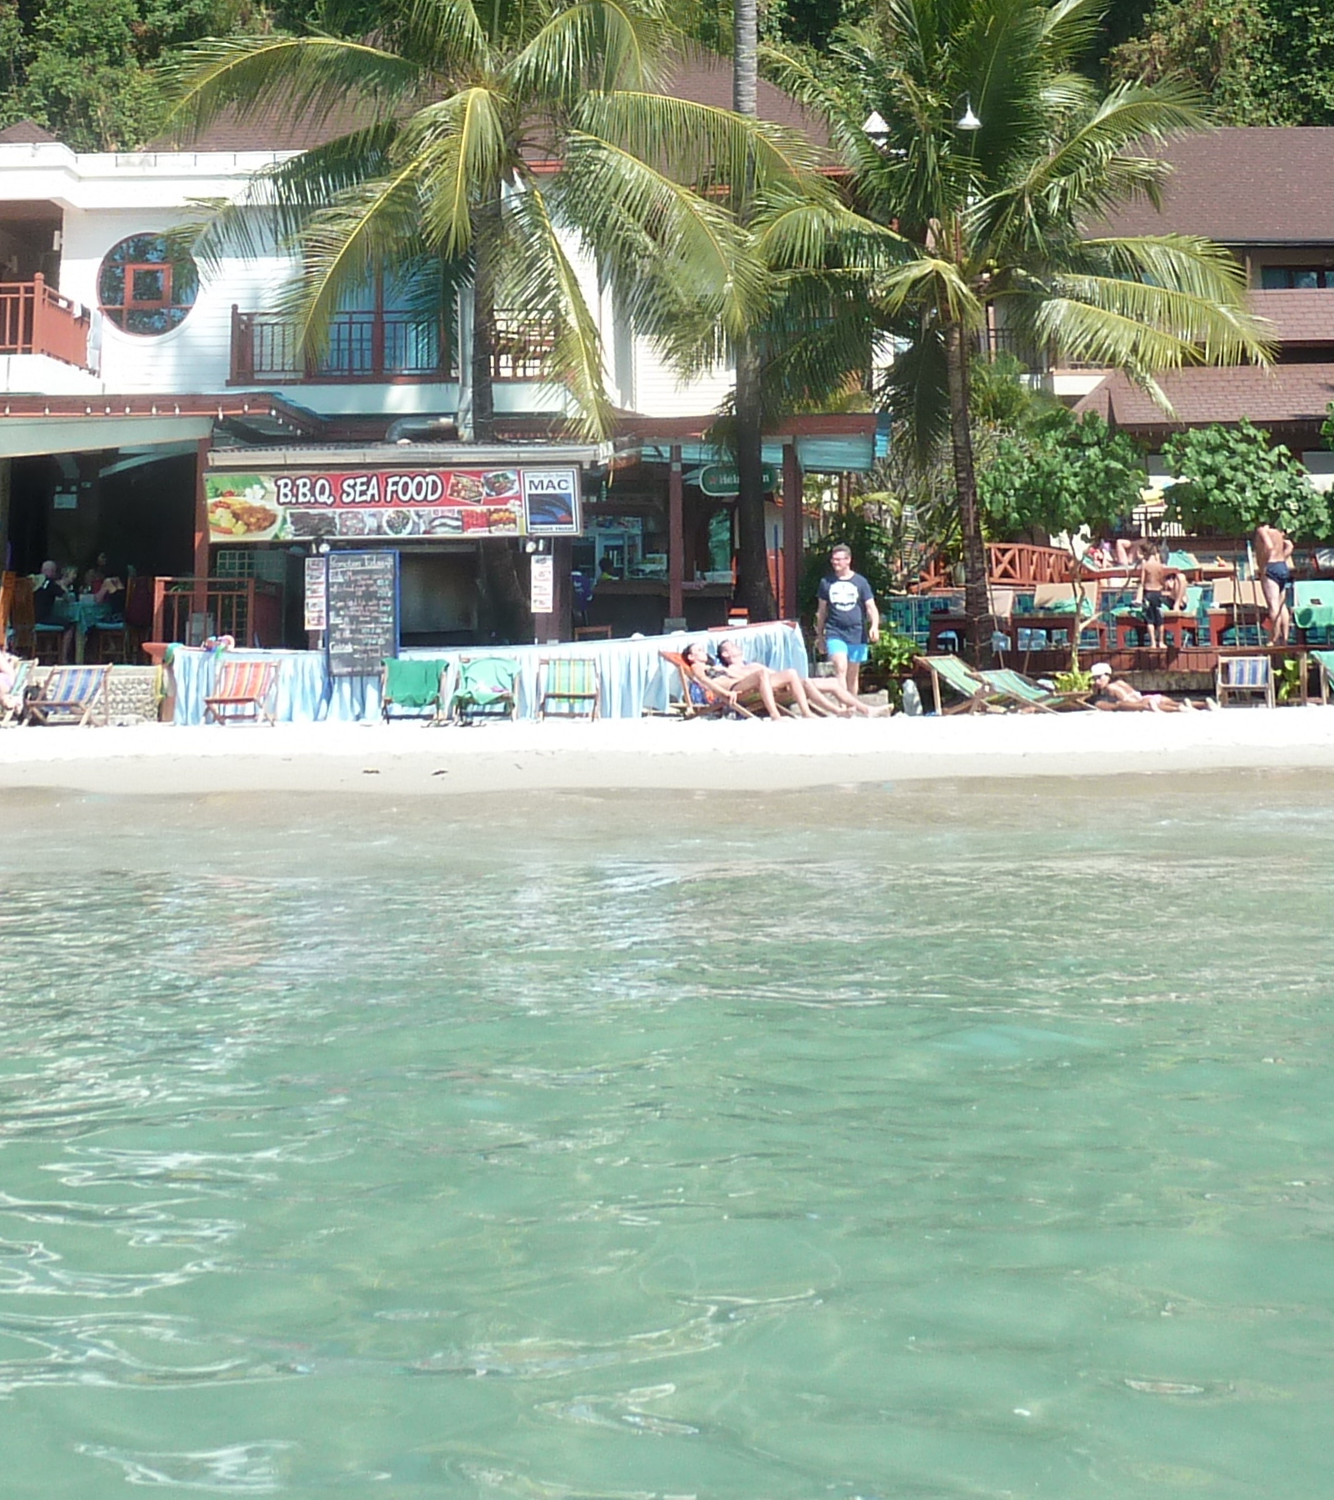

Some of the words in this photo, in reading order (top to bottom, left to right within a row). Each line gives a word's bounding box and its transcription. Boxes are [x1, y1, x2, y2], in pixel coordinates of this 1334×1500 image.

[341, 475, 380, 504] SEA
[385, 474, 443, 503] FOOD
[528, 479, 570, 491] MAC
